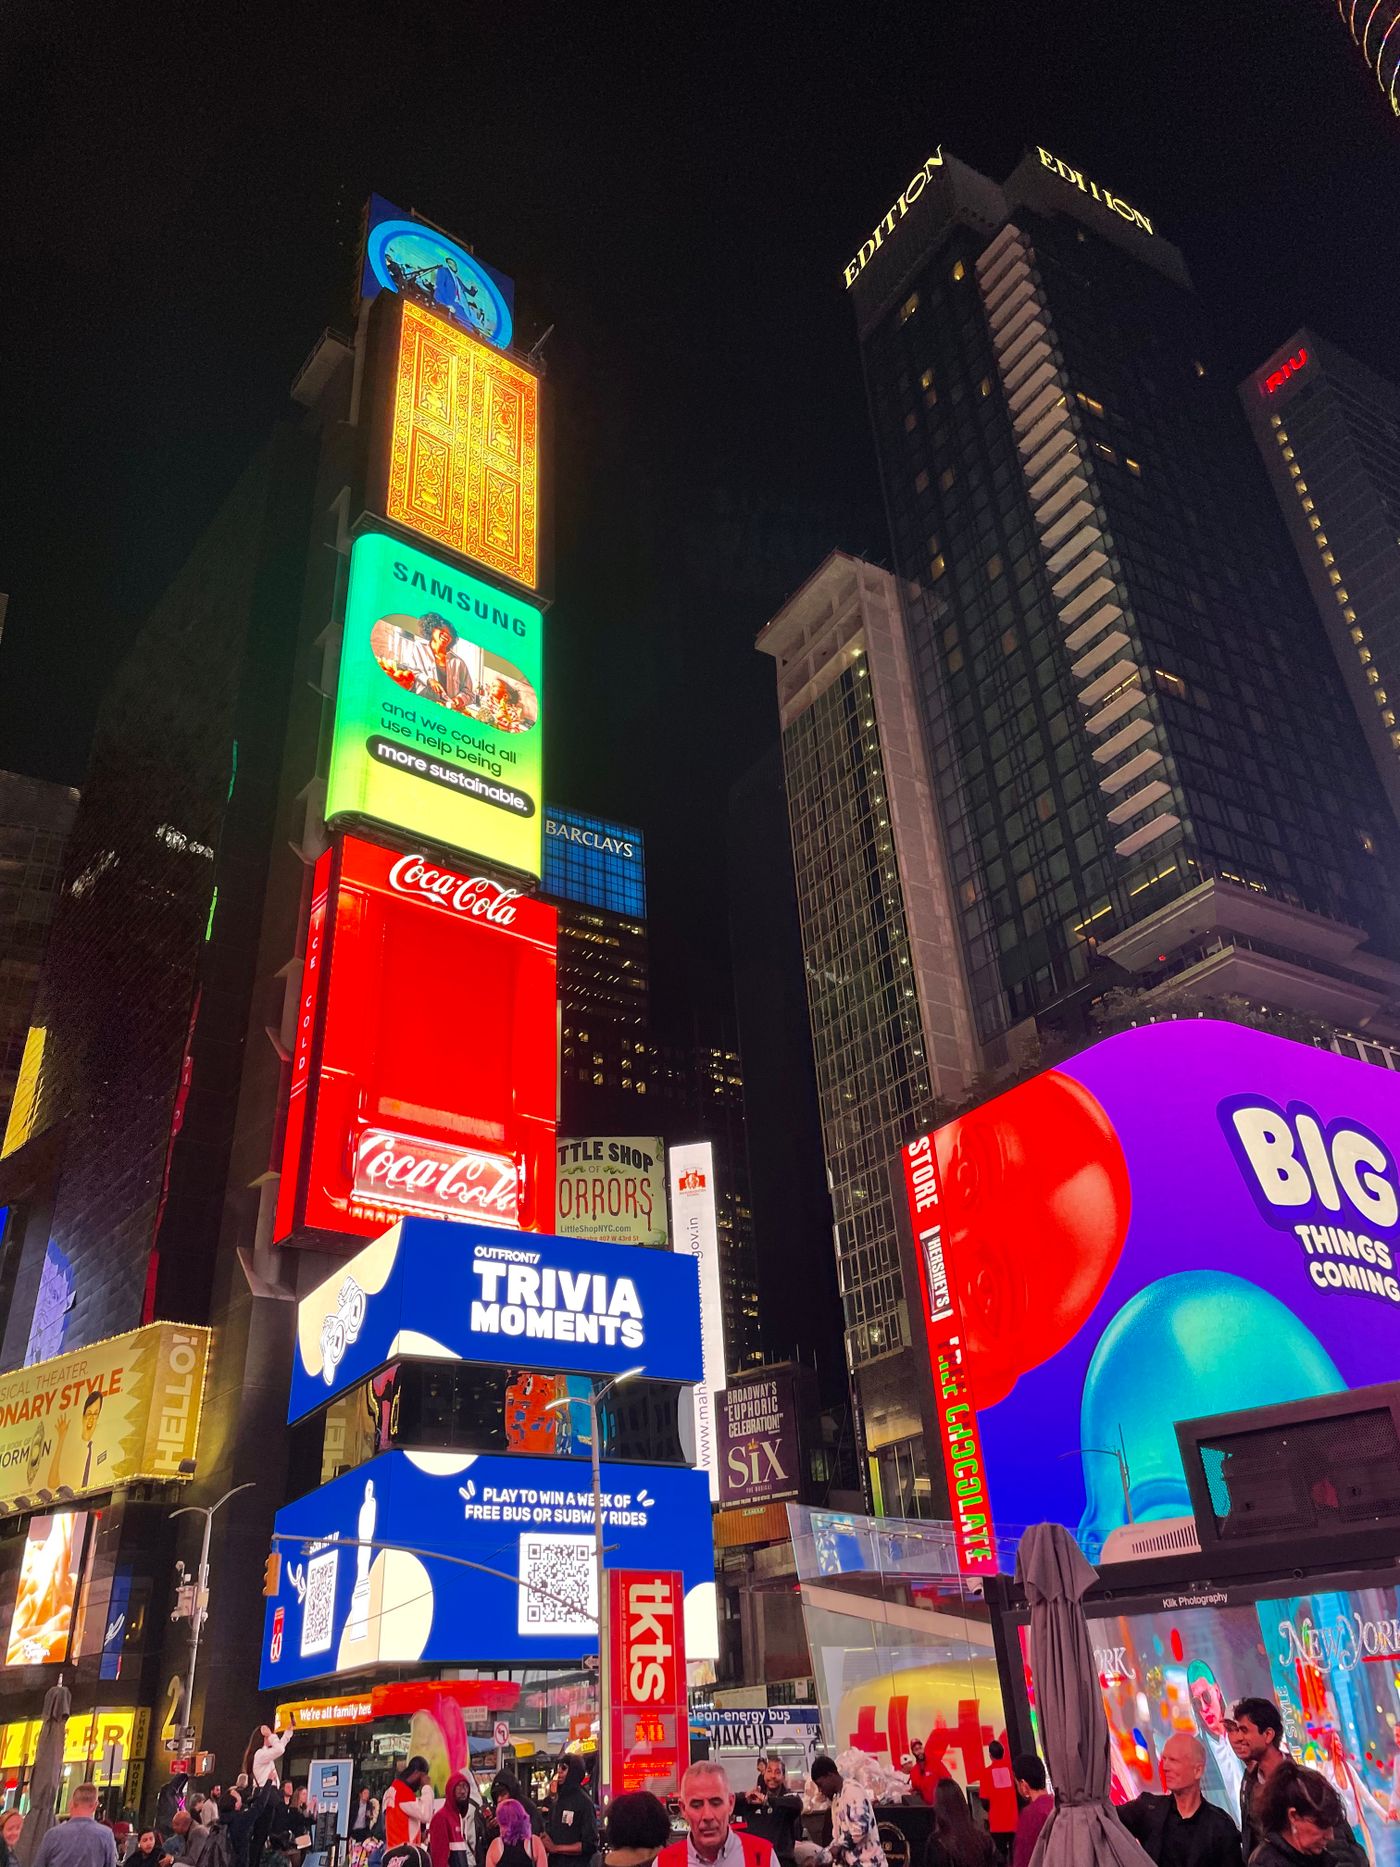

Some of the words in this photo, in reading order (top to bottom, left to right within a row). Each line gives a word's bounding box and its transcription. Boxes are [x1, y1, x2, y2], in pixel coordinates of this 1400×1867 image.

[843, 145, 942, 289] EDITION
[1265, 348, 1308, 392] RIU
[392, 561, 526, 637] SAMSUNG
[381, 701, 416, 723] and
[420, 715, 447, 735] we
[451, 729, 496, 755] could
[499, 748, 517, 764] all
[381, 717, 412, 738] use
[416, 729, 452, 755] help
[456, 745, 502, 778] being
[377, 743, 427, 772] more
[429, 763, 528, 812] sustainable.
[545, 819, 633, 858] BARCLAYS
[389, 854, 524, 926] Coca-Cola
[298, 995, 313, 1070] COLD
[608, 1142, 654, 1174] SHOP
[908, 1136, 939, 1213] STORE
[1232, 1107, 1398, 1227] BIG
[558, 1177, 653, 1232] ORRORS
[560, 1225, 632, 1234] LittleShopNYC.com
[927, 1235, 950, 1308] HERSHEY'S
[1294, 1224, 1392, 1270] THINGS
[472, 1259, 643, 1319] TRIVIA
[1309, 1261, 1400, 1302] COMING
[470, 1301, 644, 1348] MOMENTS
[154, 1333, 198, 1470] HELLO!
[727, 1381, 777, 1404] BROADWAY'S
[465, 1504, 501, 1520] FREE
[503, 1506, 531, 1521] BUS
[533, 1507, 552, 1522] OR
[554, 1509, 608, 1525] SUBWAY
[609, 1511, 647, 1526] RIDES
[483, 1487, 518, 1503] PLAY
[520, 1489, 538, 1504] TO
[539, 1490, 564, 1506] WIN
[566, 1492, 576, 1506] A
[577, 1493, 612, 1508] WEEK
[613, 1494, 631, 1508] OF
[1163, 1598, 1178, 1608] Klik
[1179, 1592, 1228, 1608] Photography
[629, 1579, 674, 1702] tkts
[300, 1706, 320, 1720] We're
[321, 1705, 332, 1719] all
[333, 1704, 358, 1720] family
[769, 1708, 791, 1724] bus
